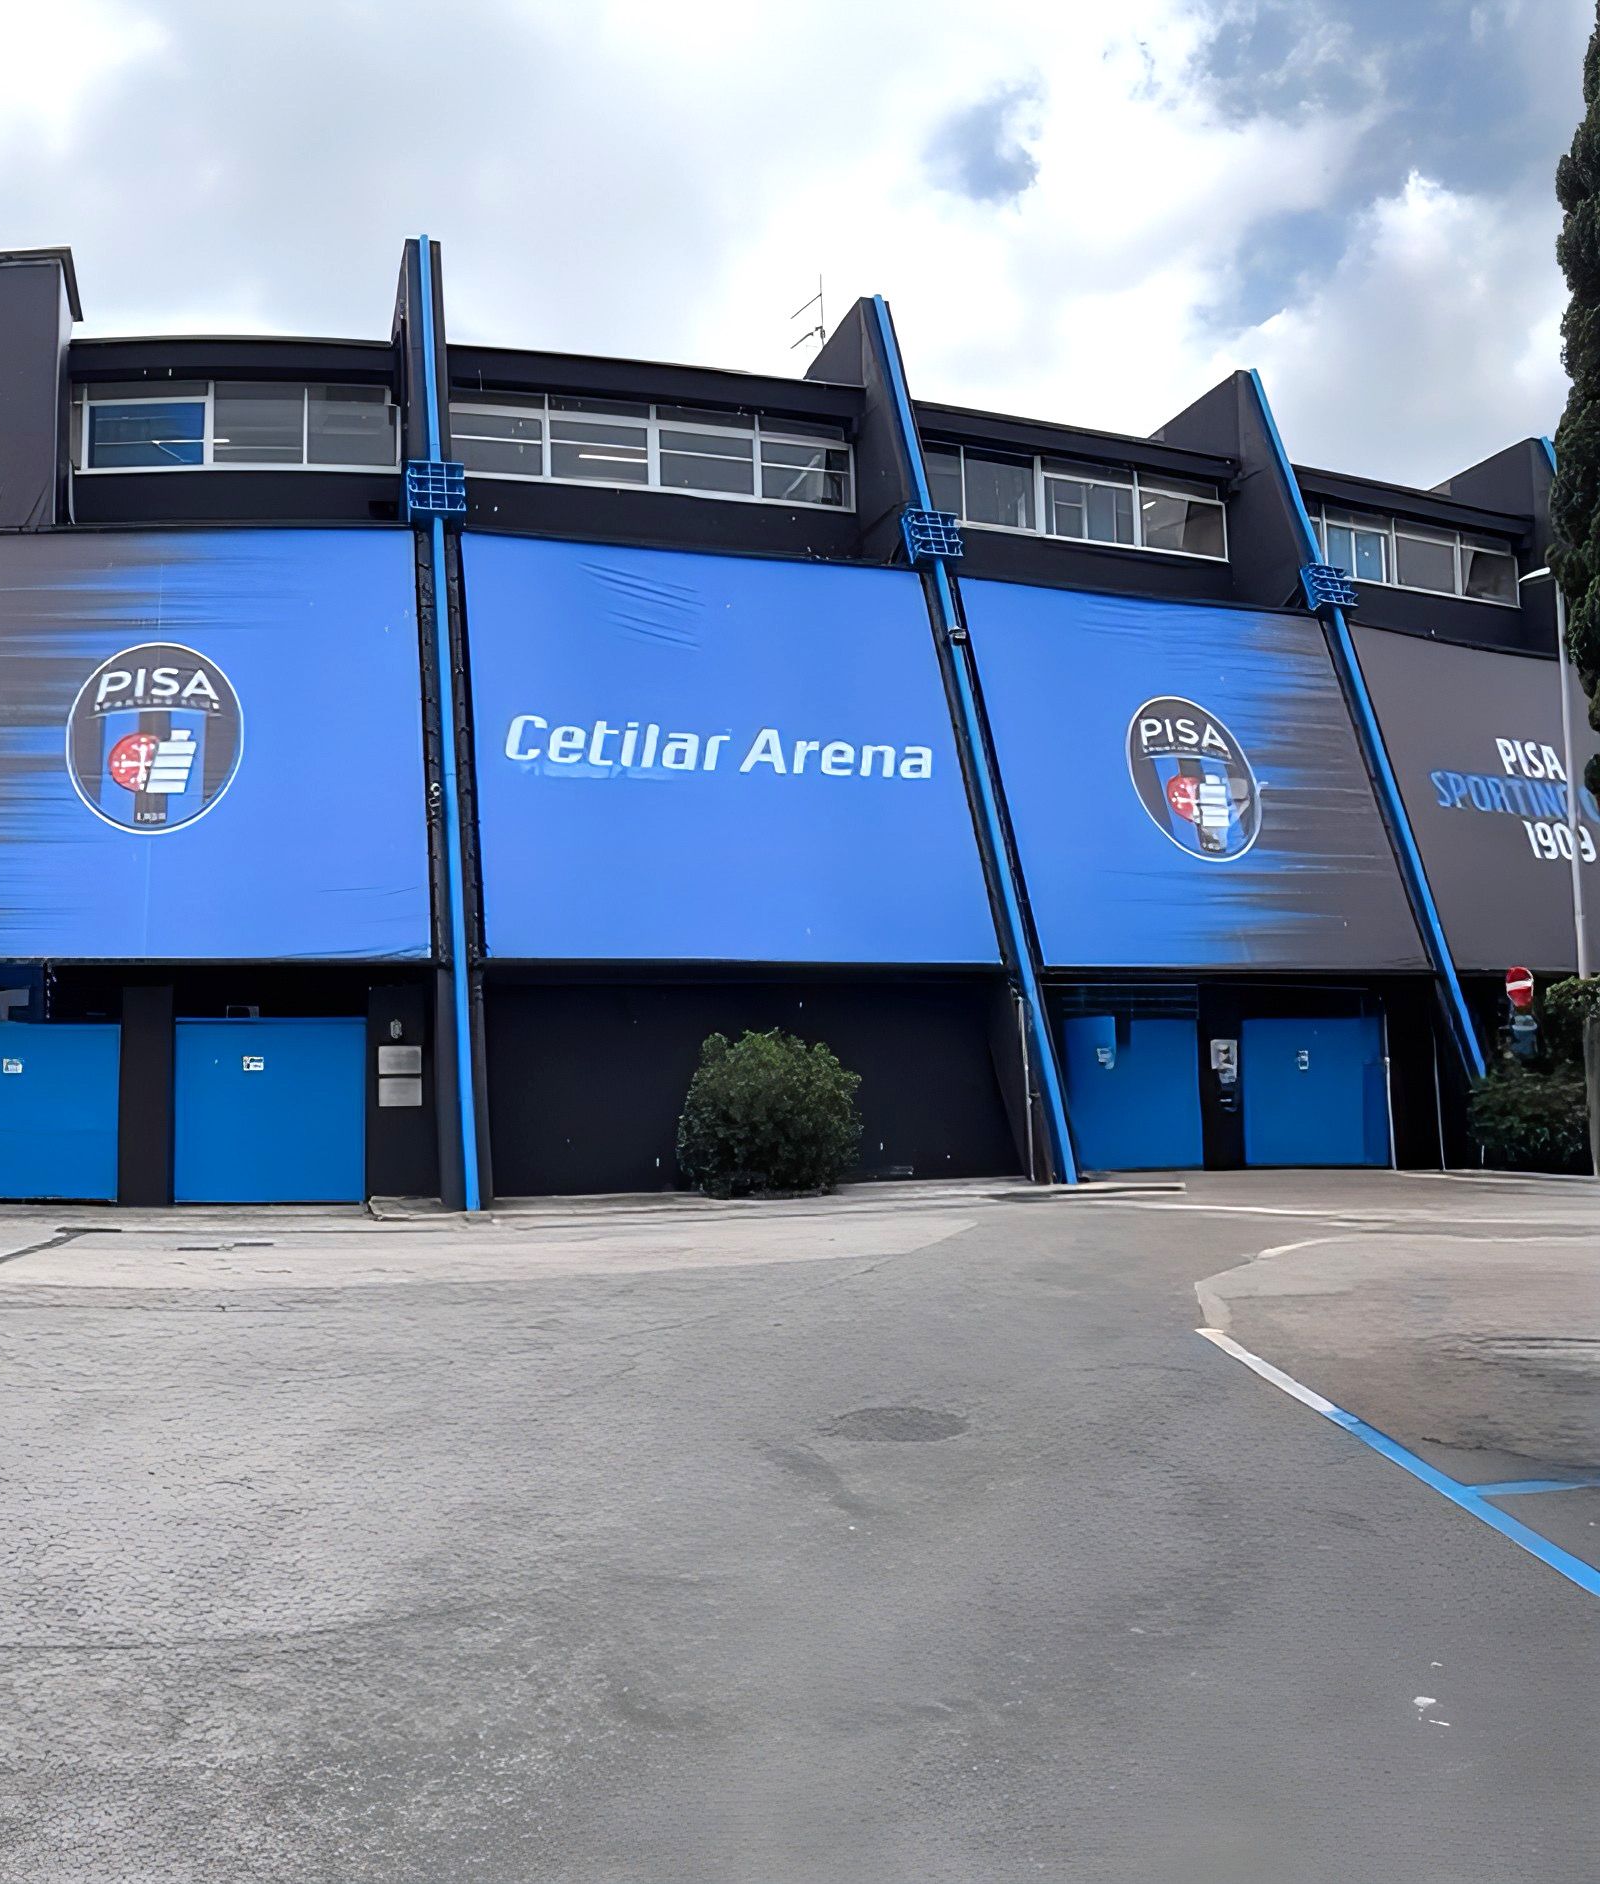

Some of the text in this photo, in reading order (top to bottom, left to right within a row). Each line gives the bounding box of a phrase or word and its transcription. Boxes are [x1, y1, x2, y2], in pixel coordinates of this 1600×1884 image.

[96, 667, 220, 703] PISA
[505, 714, 933, 779] Cetilar Arena
[1139, 718, 1232, 760] PISA
[1495, 737, 1568, 782] PISA
[1522, 820, 1596, 863] 1909
